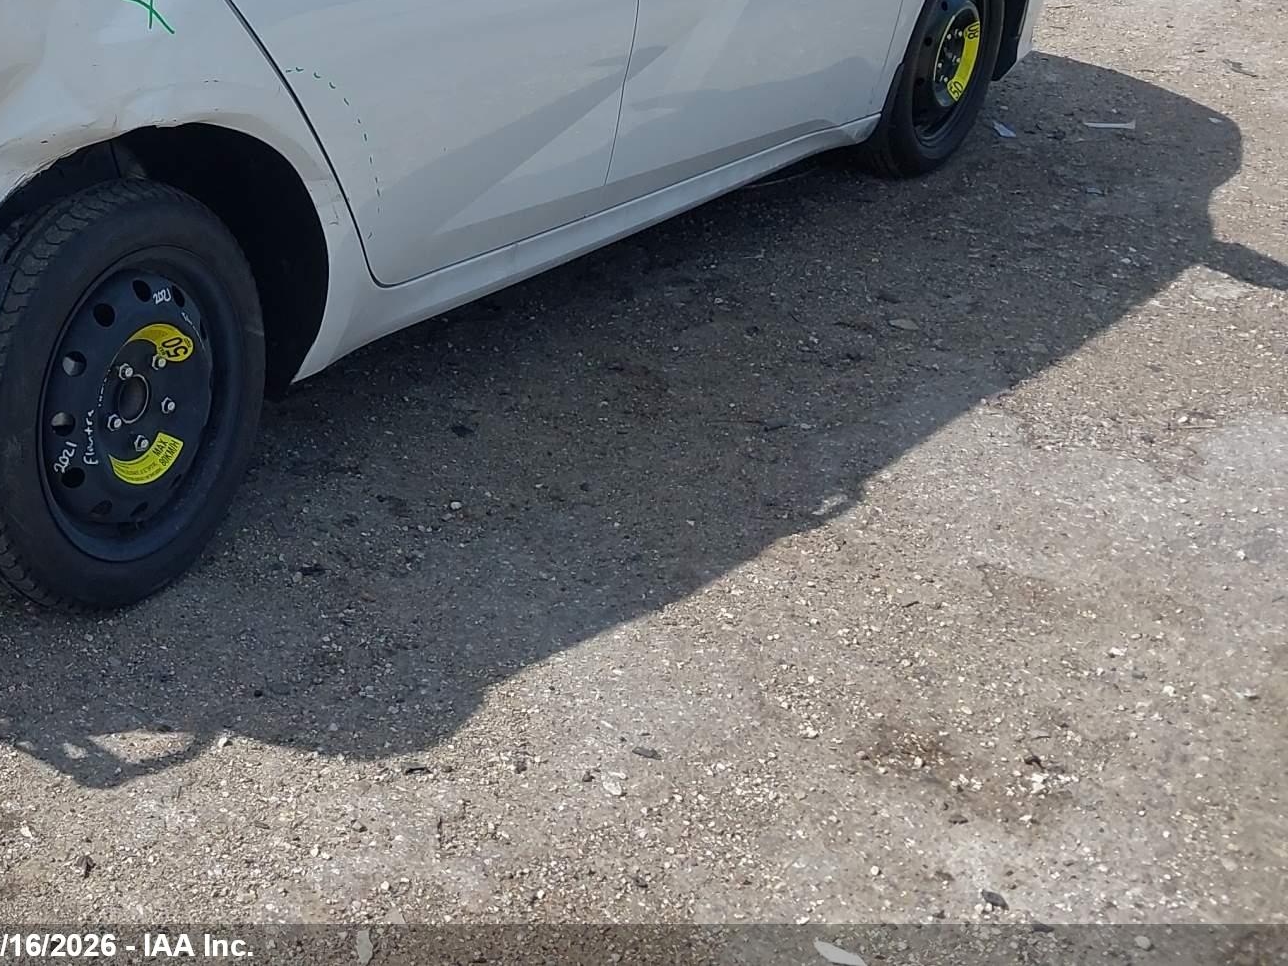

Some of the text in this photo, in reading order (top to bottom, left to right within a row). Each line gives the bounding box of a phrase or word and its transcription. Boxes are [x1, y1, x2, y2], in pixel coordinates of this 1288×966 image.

[161, 337, 189, 358] 50
[53, 441, 78, 473] 2021
[152, 438, 169, 457] MAX
